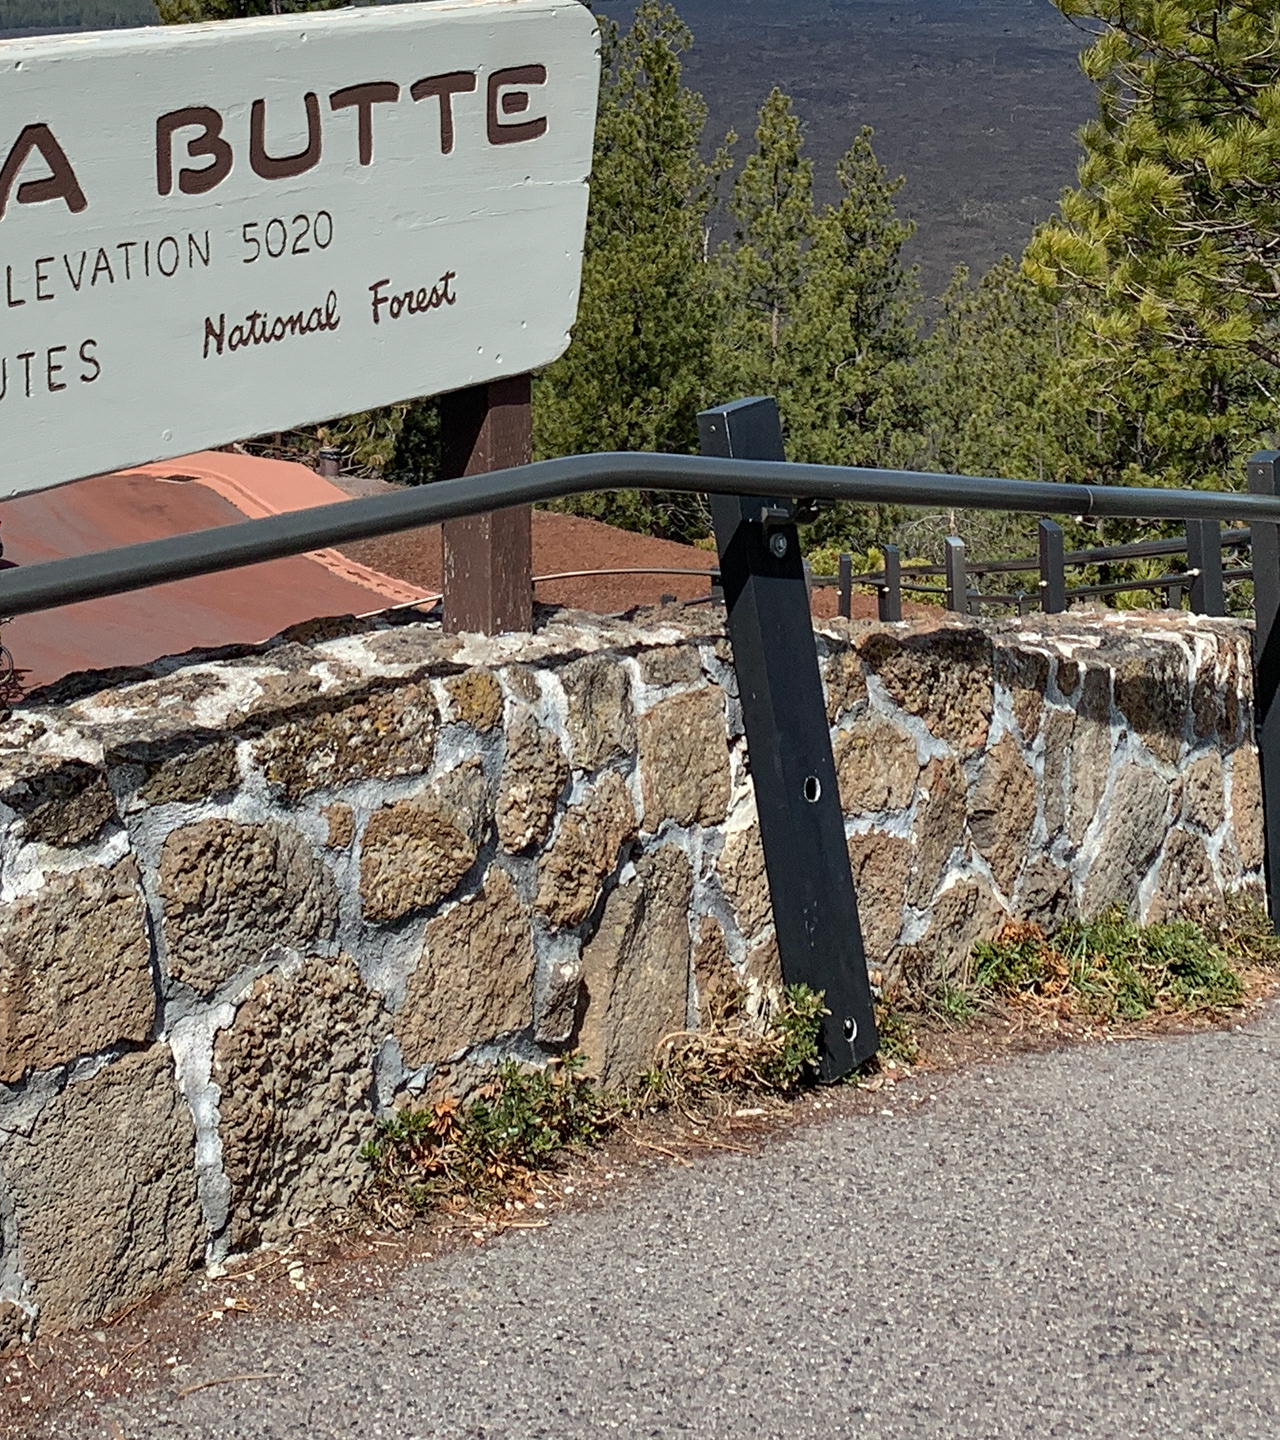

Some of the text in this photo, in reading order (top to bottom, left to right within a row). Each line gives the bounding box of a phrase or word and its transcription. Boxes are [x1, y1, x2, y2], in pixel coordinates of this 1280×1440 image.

[155, 62, 548, 197] BUTTE
[242, 208, 333, 264] 5020
[202, 289, 341, 359] National
[369, 270, 457, 325] Forest
